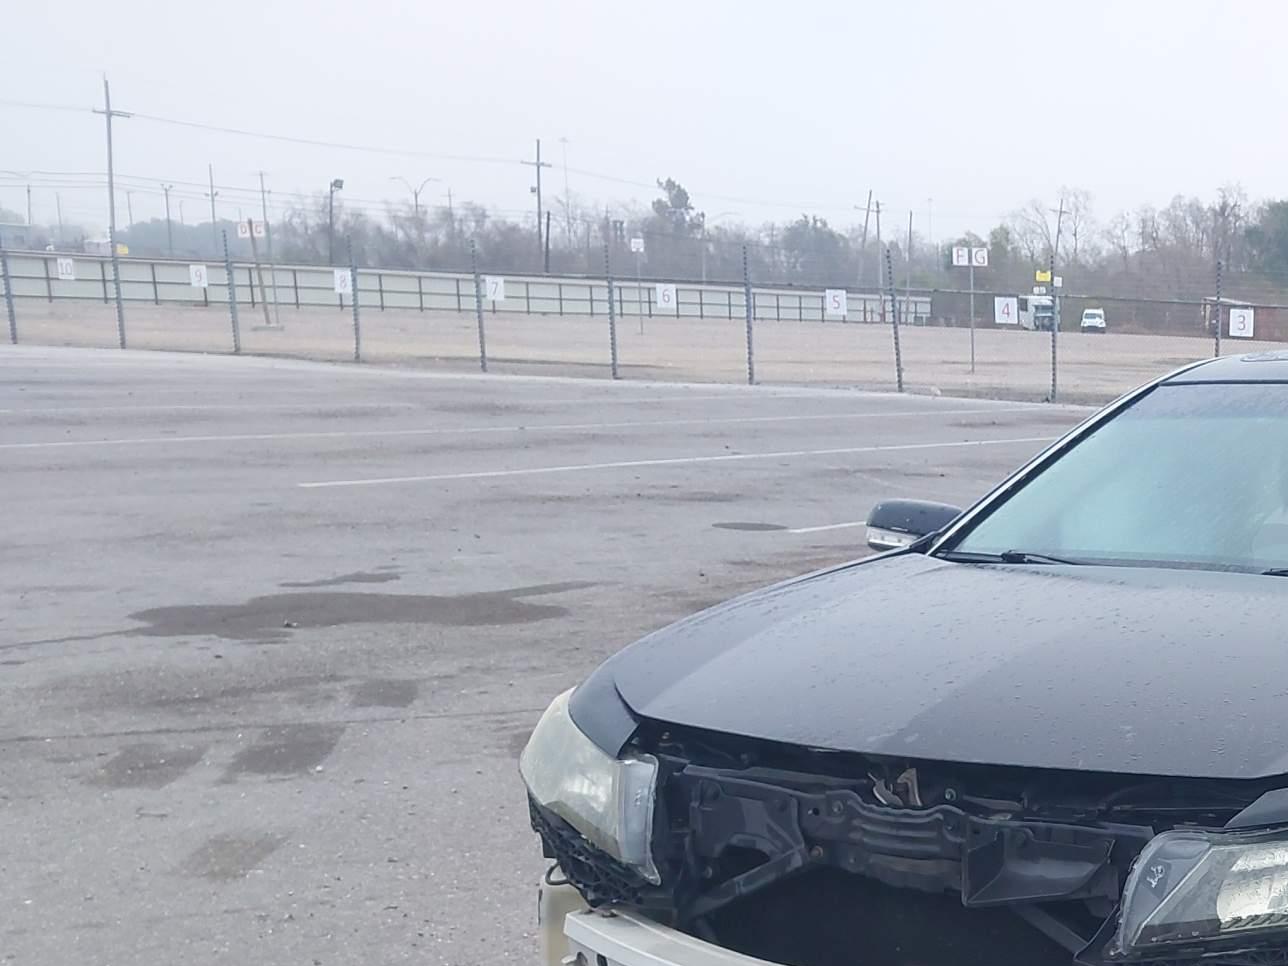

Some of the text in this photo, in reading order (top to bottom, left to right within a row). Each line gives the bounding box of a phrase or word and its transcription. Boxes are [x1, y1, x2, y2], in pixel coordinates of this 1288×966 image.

[956, 248, 986, 265] F G
[59, 262, 73, 276] 10
[491, 281, 498, 294] 7
[662, 290, 671, 303] 6
[832, 295, 841, 309] 5
[1001, 303, 1010, 318] 4
[1237, 314, 1246, 331] 3
